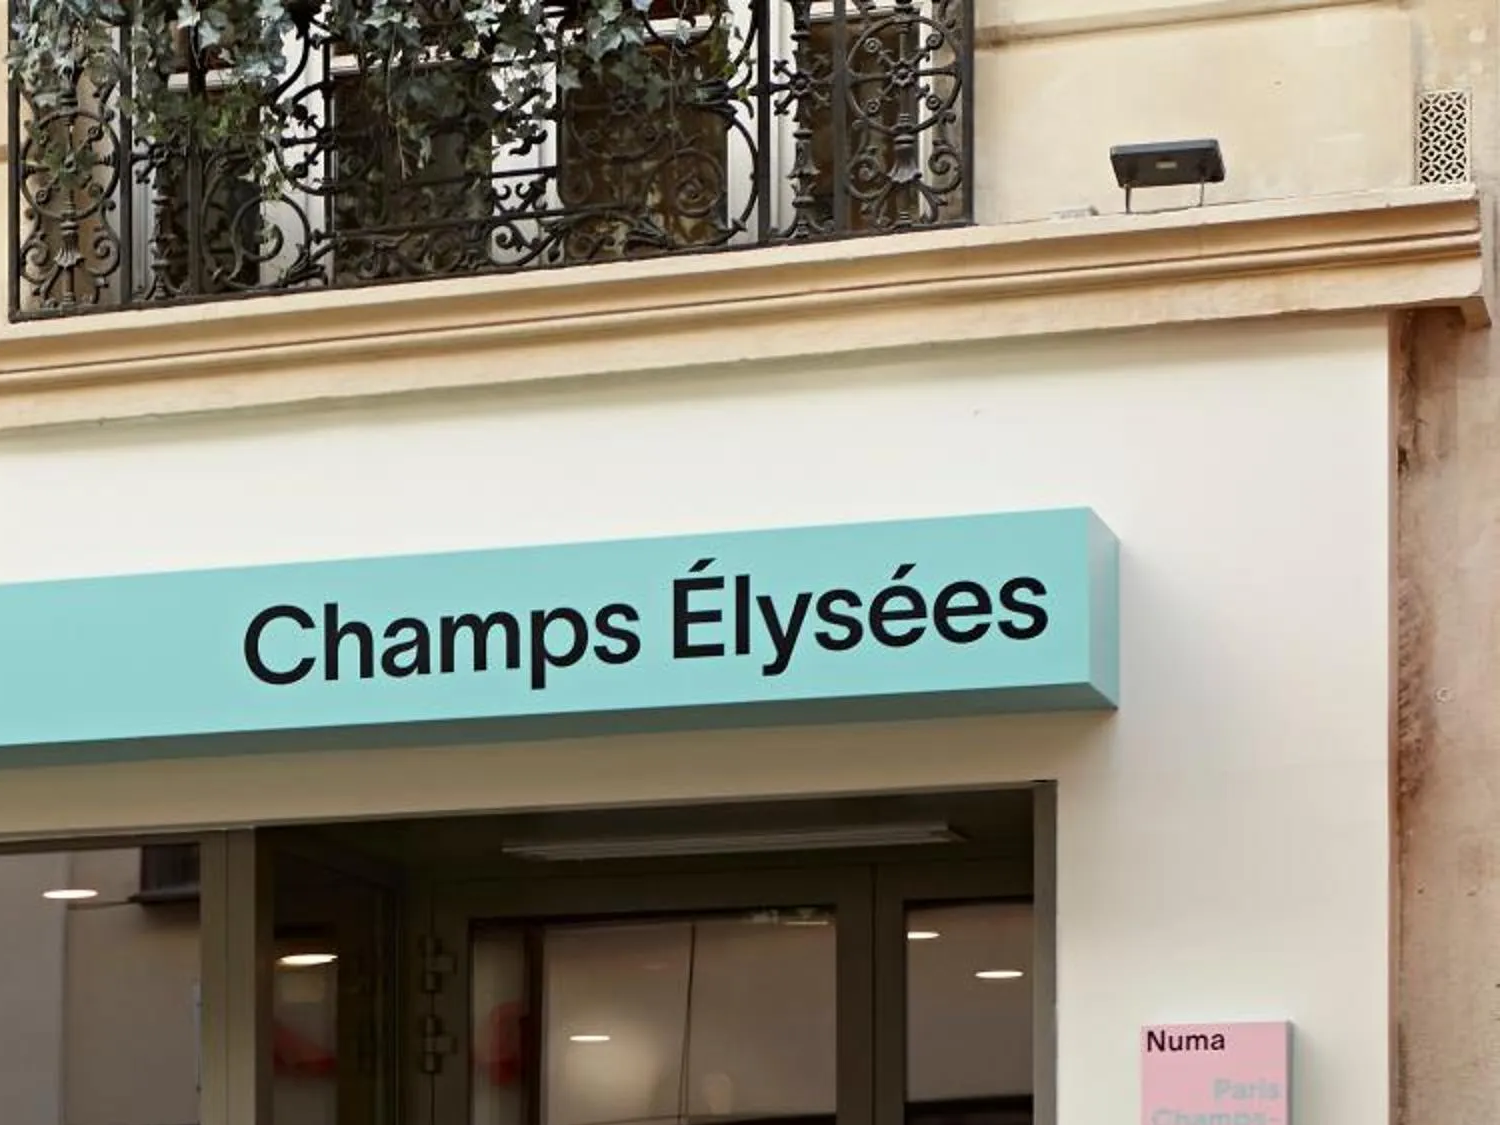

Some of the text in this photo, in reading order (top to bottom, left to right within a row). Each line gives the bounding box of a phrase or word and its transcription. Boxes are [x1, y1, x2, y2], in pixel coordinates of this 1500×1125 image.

[244, 557, 1049, 690] Champs Élysées
[1147, 1029, 1226, 1052] Numa
[1212, 1078, 1281, 1100] Paris
